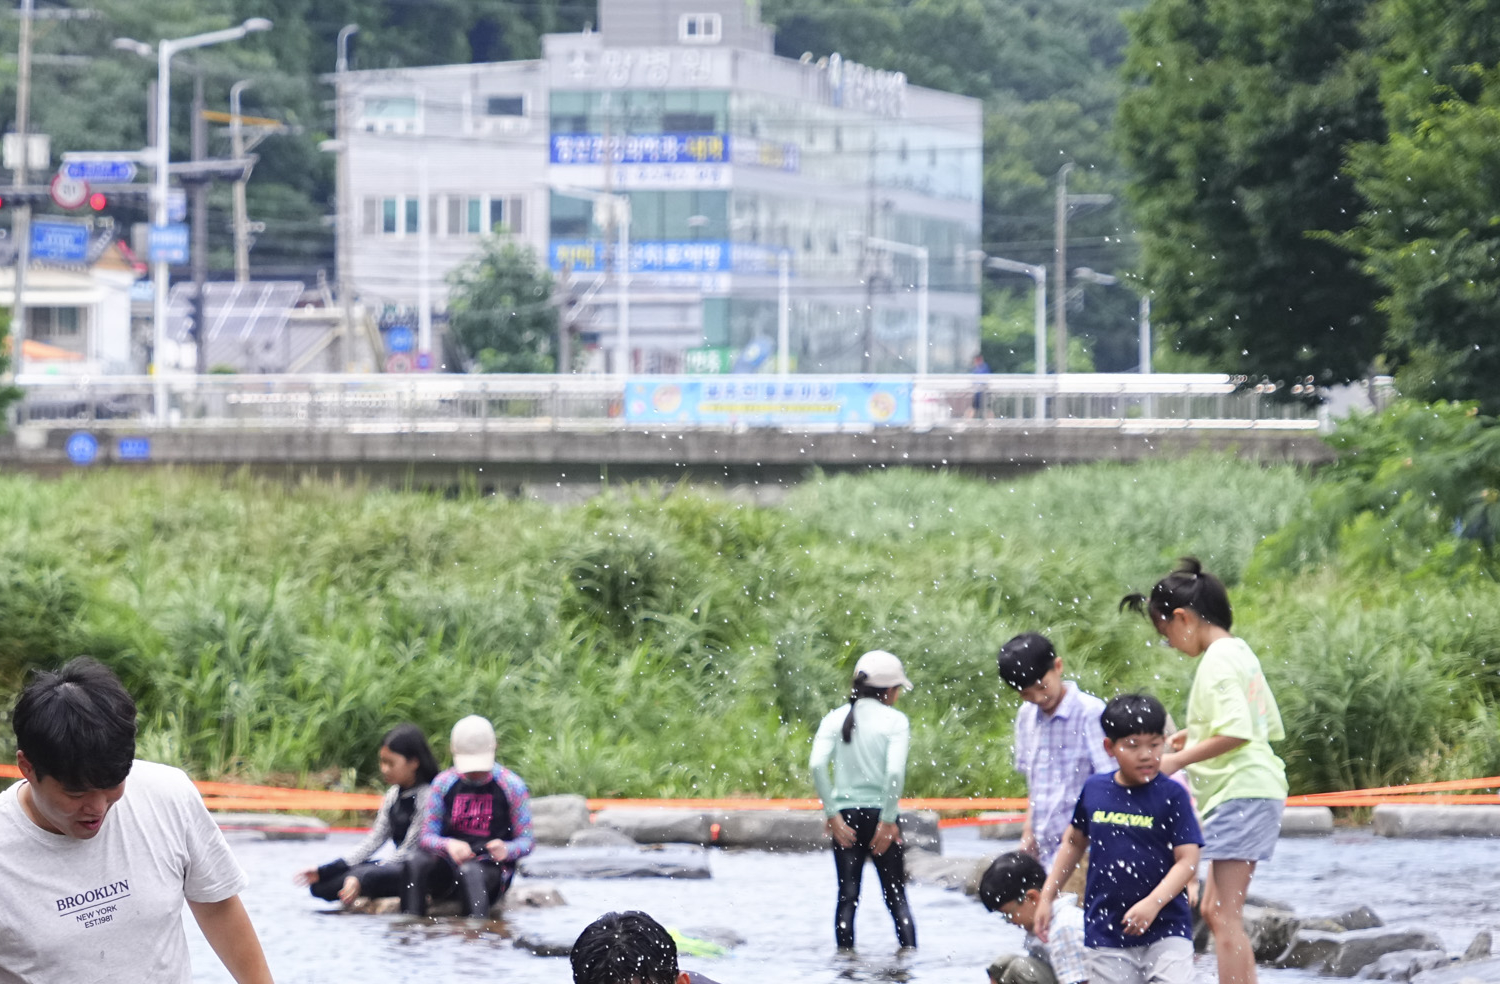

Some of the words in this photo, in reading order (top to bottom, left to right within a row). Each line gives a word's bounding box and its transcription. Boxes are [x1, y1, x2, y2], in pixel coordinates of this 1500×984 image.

[1092, 811, 1154, 828] BLACKYAK
[56, 880, 130, 911] BROOKLYN
[76, 911, 94, 922] NEW
[96, 904, 117, 916] YORK
[84, 914, 113, 929] EST.1981
